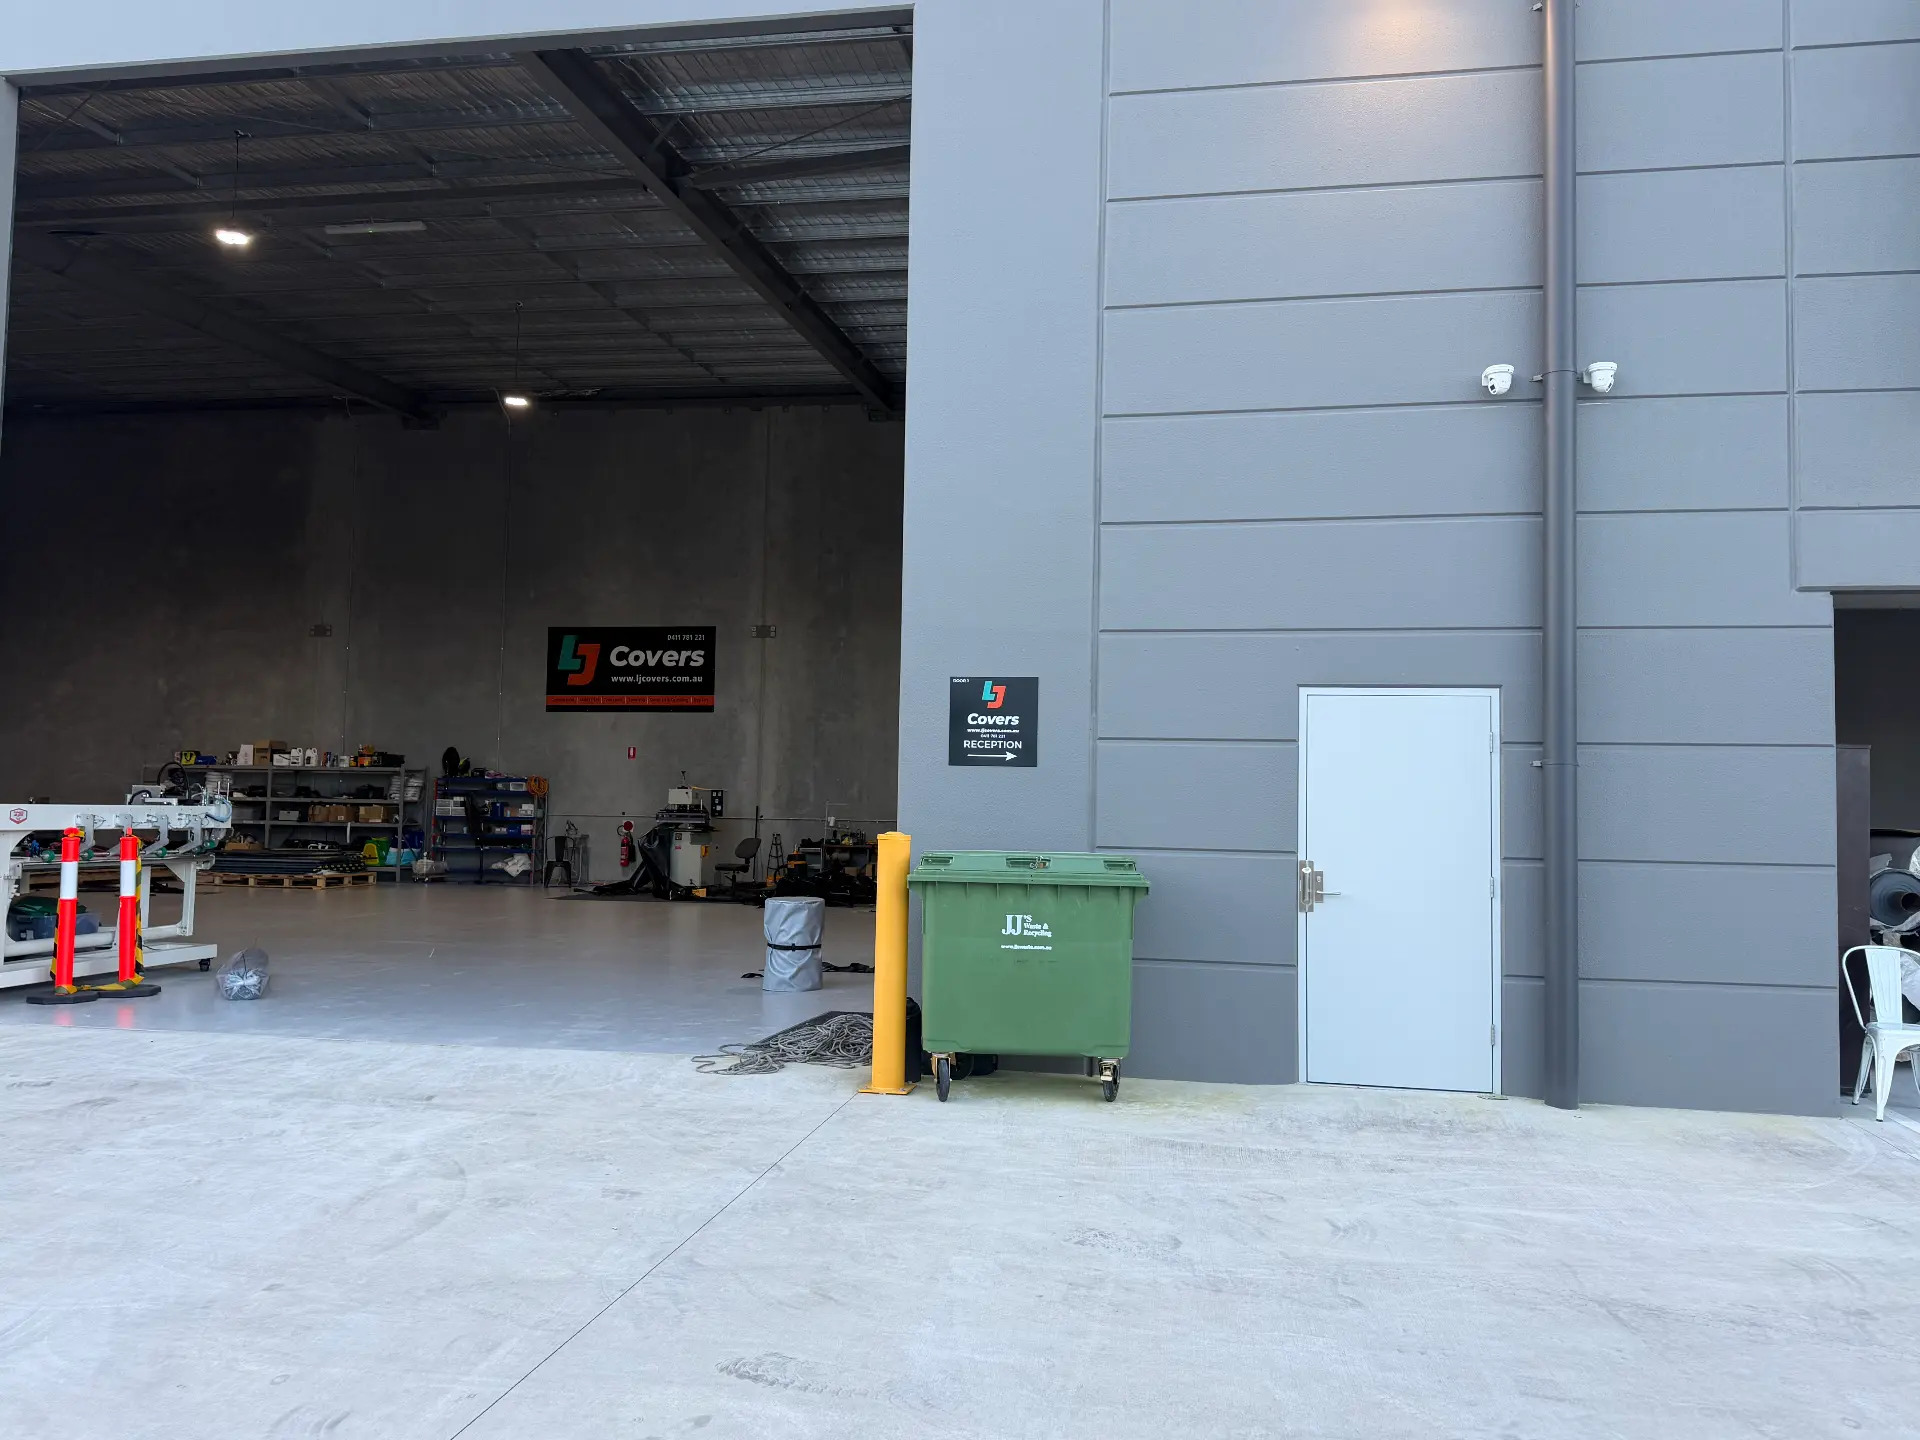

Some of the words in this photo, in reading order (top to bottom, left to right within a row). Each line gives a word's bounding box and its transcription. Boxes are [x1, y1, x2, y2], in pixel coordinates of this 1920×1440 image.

[557, 634, 601, 686] LJ
[609, 645, 705, 667] Covers
[611, 674, 703, 684] www.ljcovers.com.au
[982, 680, 1007, 708] LJ
[967, 712, 1020, 726] Covers
[963, 740, 1022, 749] RECEPTION
[1023, 930, 1052, 938] Recycling
